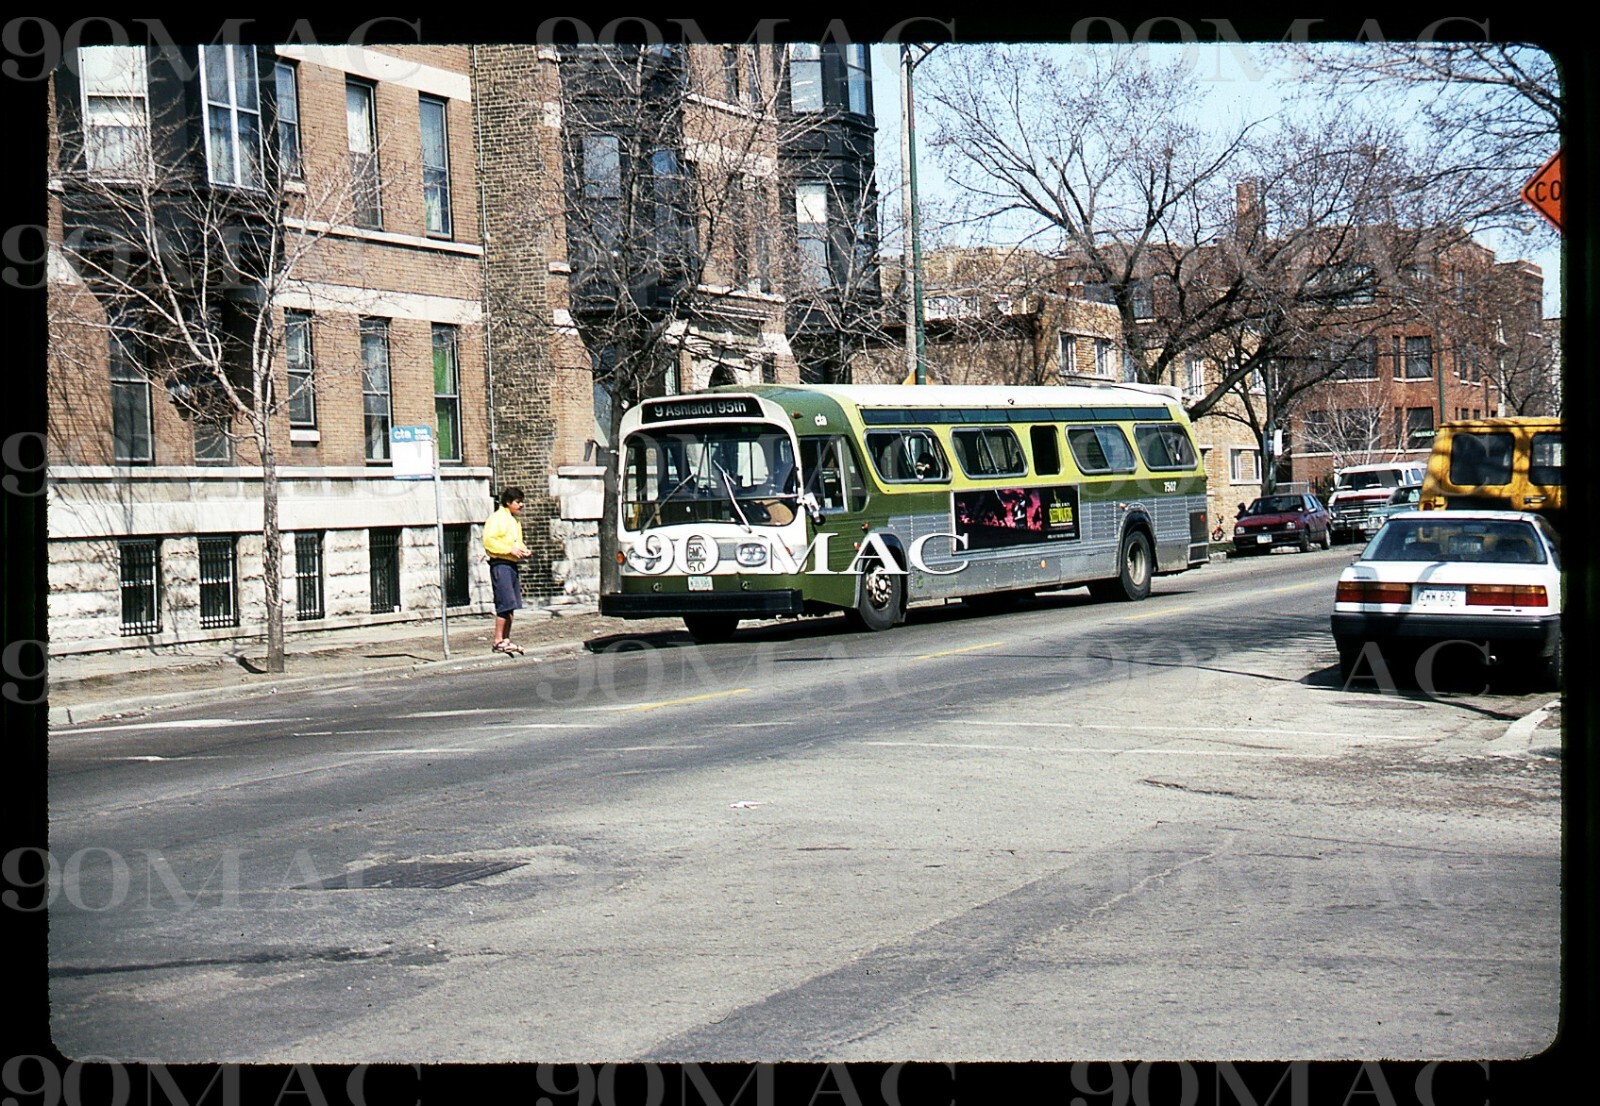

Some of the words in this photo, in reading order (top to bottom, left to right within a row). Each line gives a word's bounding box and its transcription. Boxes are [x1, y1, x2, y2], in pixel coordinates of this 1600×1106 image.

[1535, 180, 1562, 203] CO
[654, 405, 663, 418] 9
[665, 402, 713, 417] Ashland
[717, 400, 747, 415] 95th
[1163, 481, 1177, 493] 7507
[1440, 591, 1456, 602] 692
